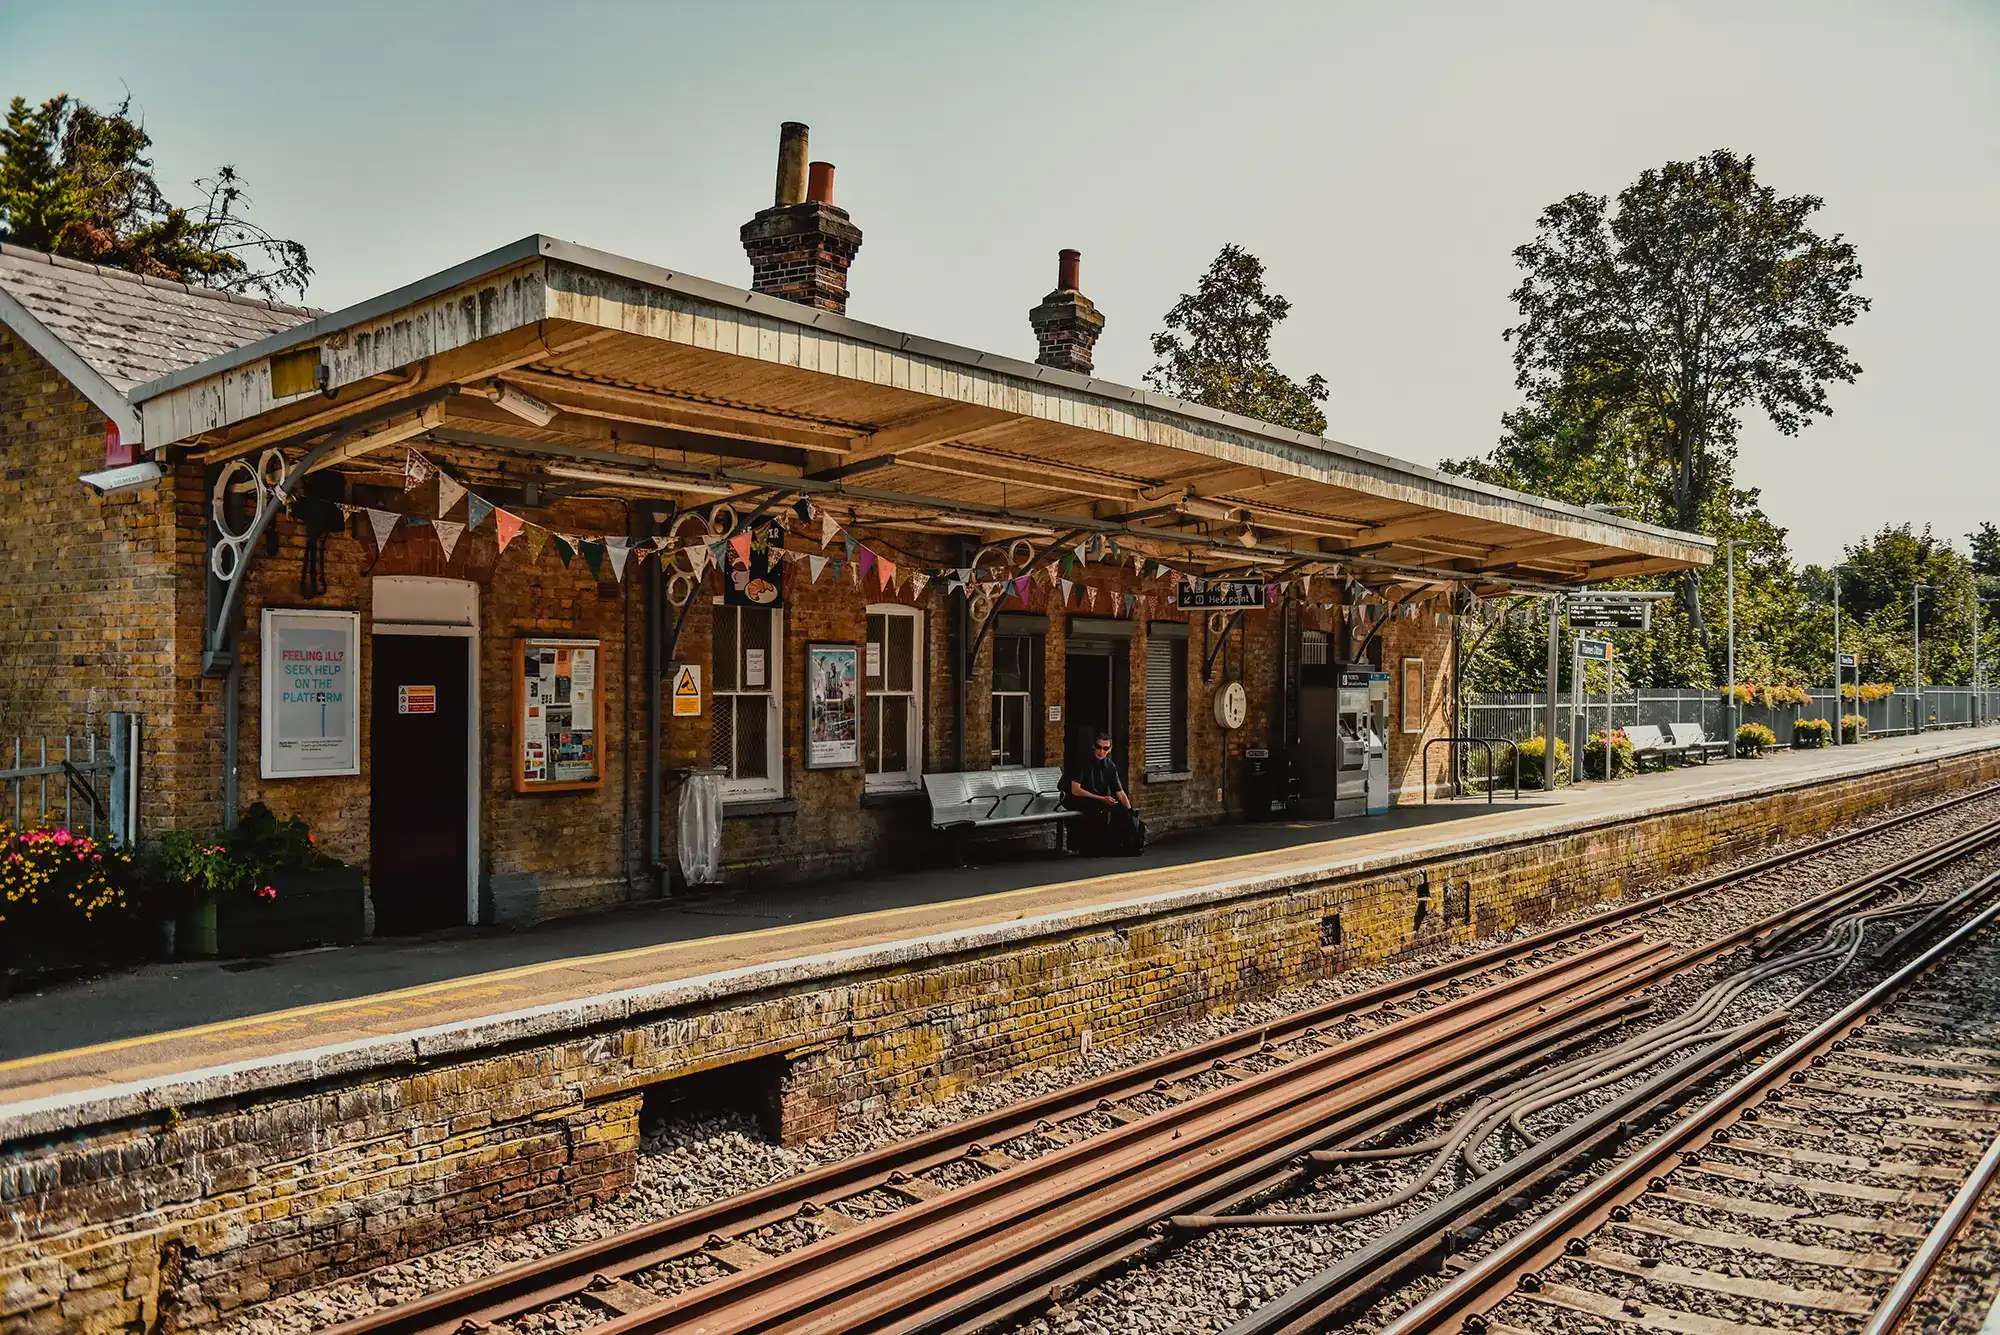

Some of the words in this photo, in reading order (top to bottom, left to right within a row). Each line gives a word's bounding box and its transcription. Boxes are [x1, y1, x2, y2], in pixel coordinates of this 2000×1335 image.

[113, 476, 140, 486] SIEMENS
[1208, 595, 1227, 605] Hep
[1228, 595, 1250, 605] pont
[282, 650, 323, 661] FEELING
[325, 651, 344, 662] ILL?
[285, 664, 313, 675] SEEK
[315, 665, 341, 675] HELP
[294, 679, 310, 689] ON
[312, 679, 333, 689] THE
[283, 692, 343, 703] PLATFRM
